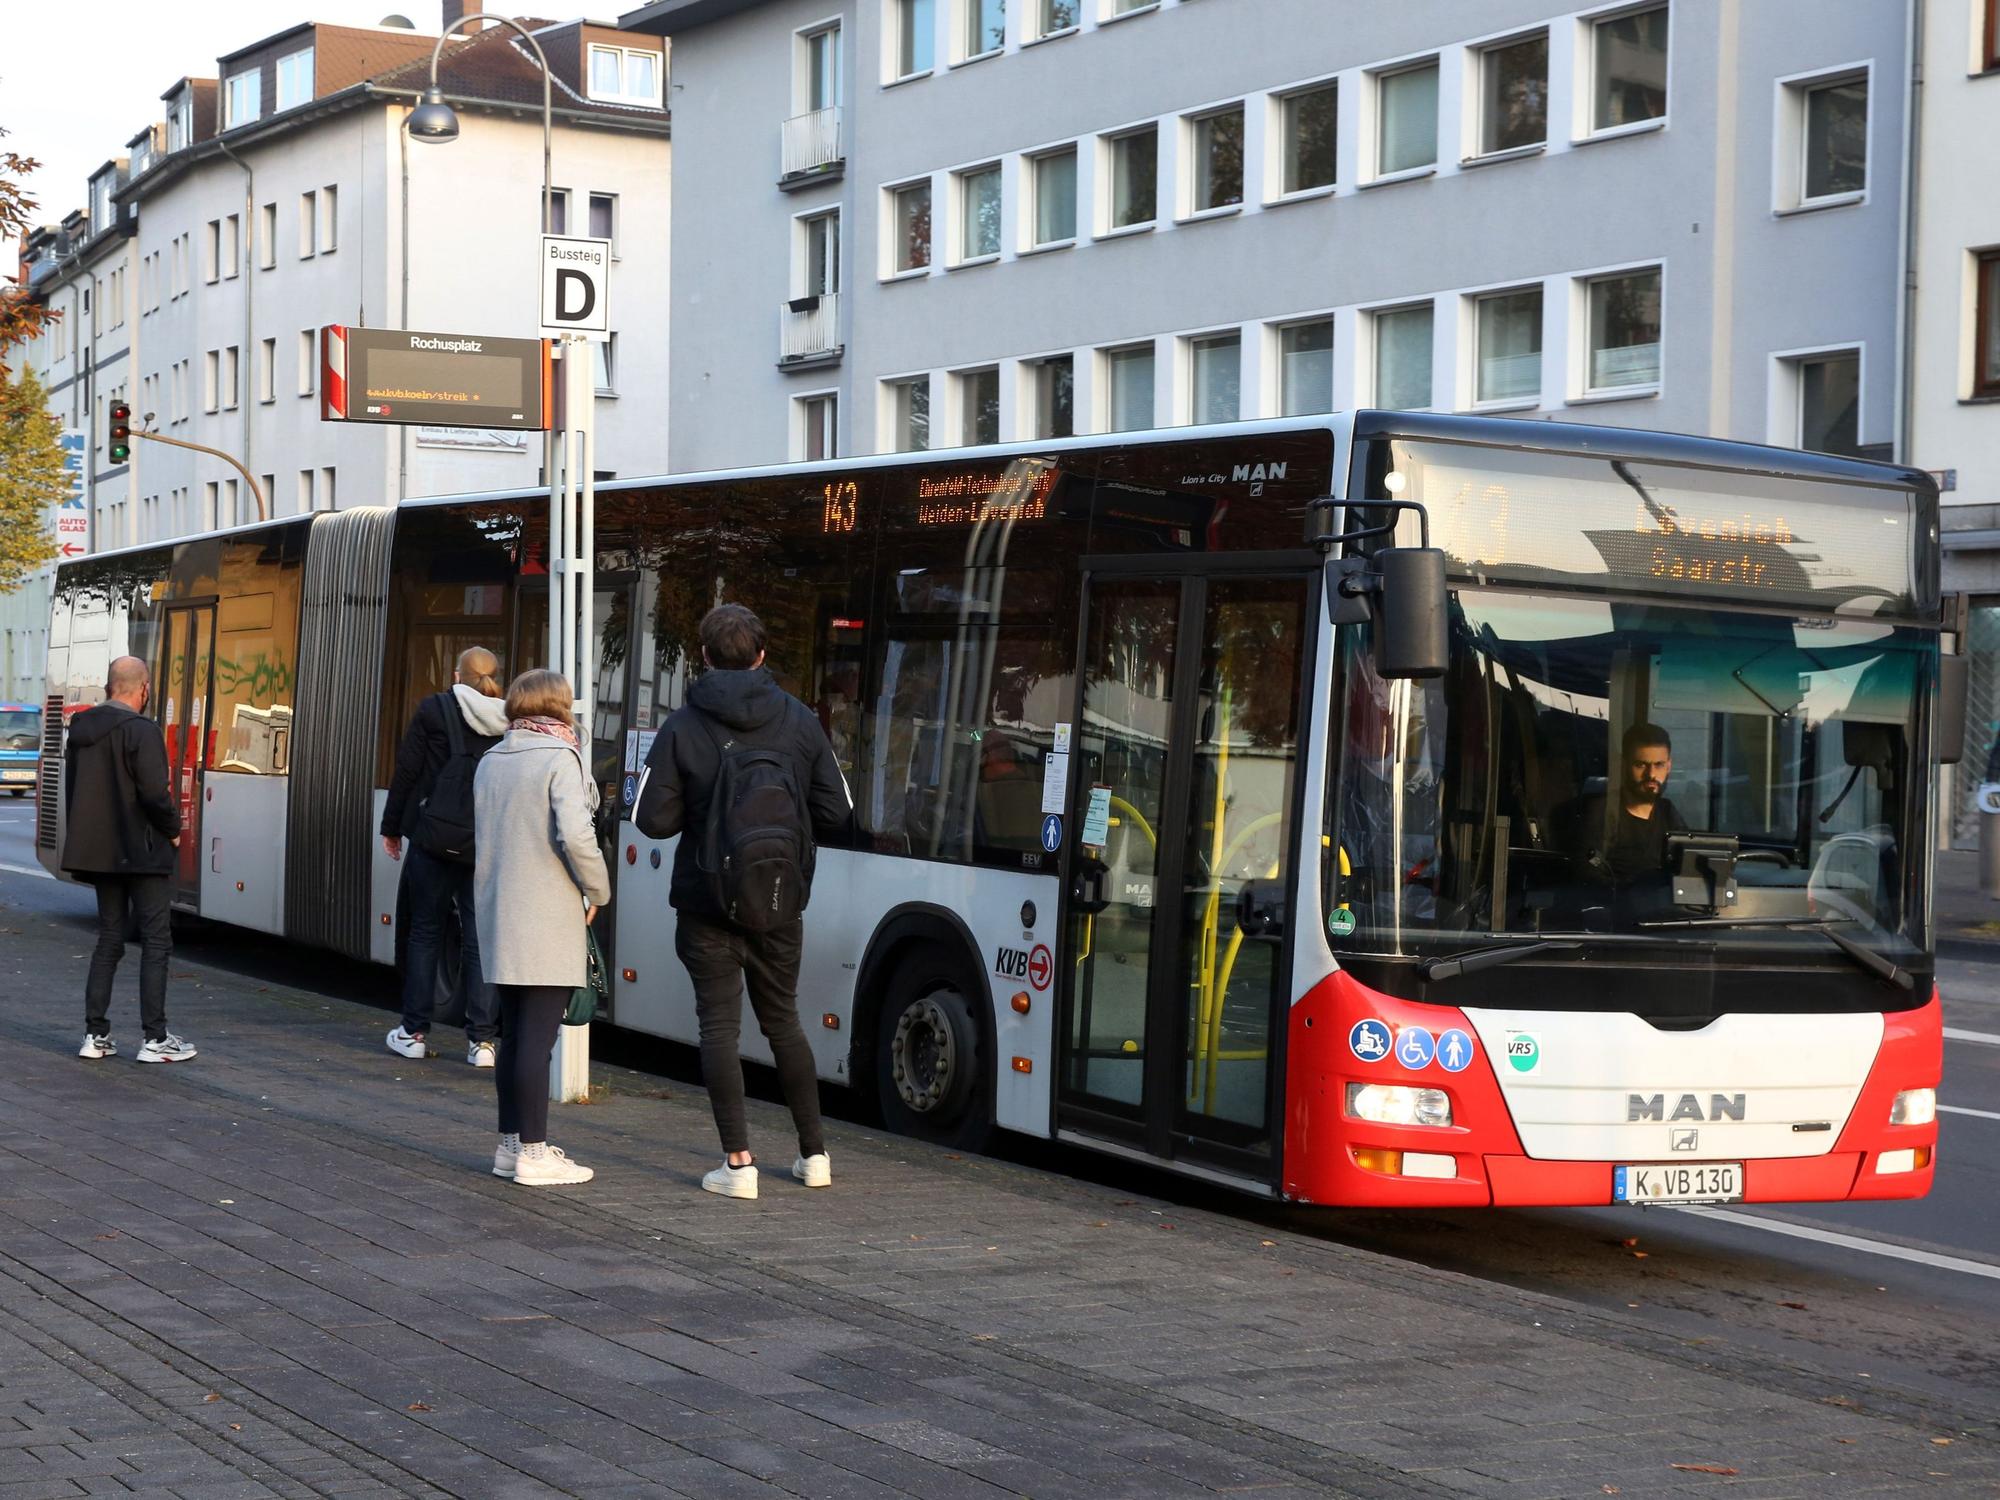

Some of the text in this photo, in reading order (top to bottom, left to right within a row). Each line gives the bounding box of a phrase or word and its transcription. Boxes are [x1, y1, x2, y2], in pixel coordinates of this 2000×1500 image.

[550, 246, 601, 264] Bussteig
[555, 268, 596, 322] D
[410, 337, 482, 352] Rochusplatz
[1181, 461, 1288, 485] Lion's City MAN
[824, 482, 857, 532] 143
[1651, 547, 1776, 588] Saarstr.
[1126, 884, 1152, 895] MA
[995, 947, 1029, 977] KVB
[1507, 1042, 1532, 1055] VRS
[1627, 1093, 1746, 1122] MAN
[1636, 1170, 1649, 1196] K
